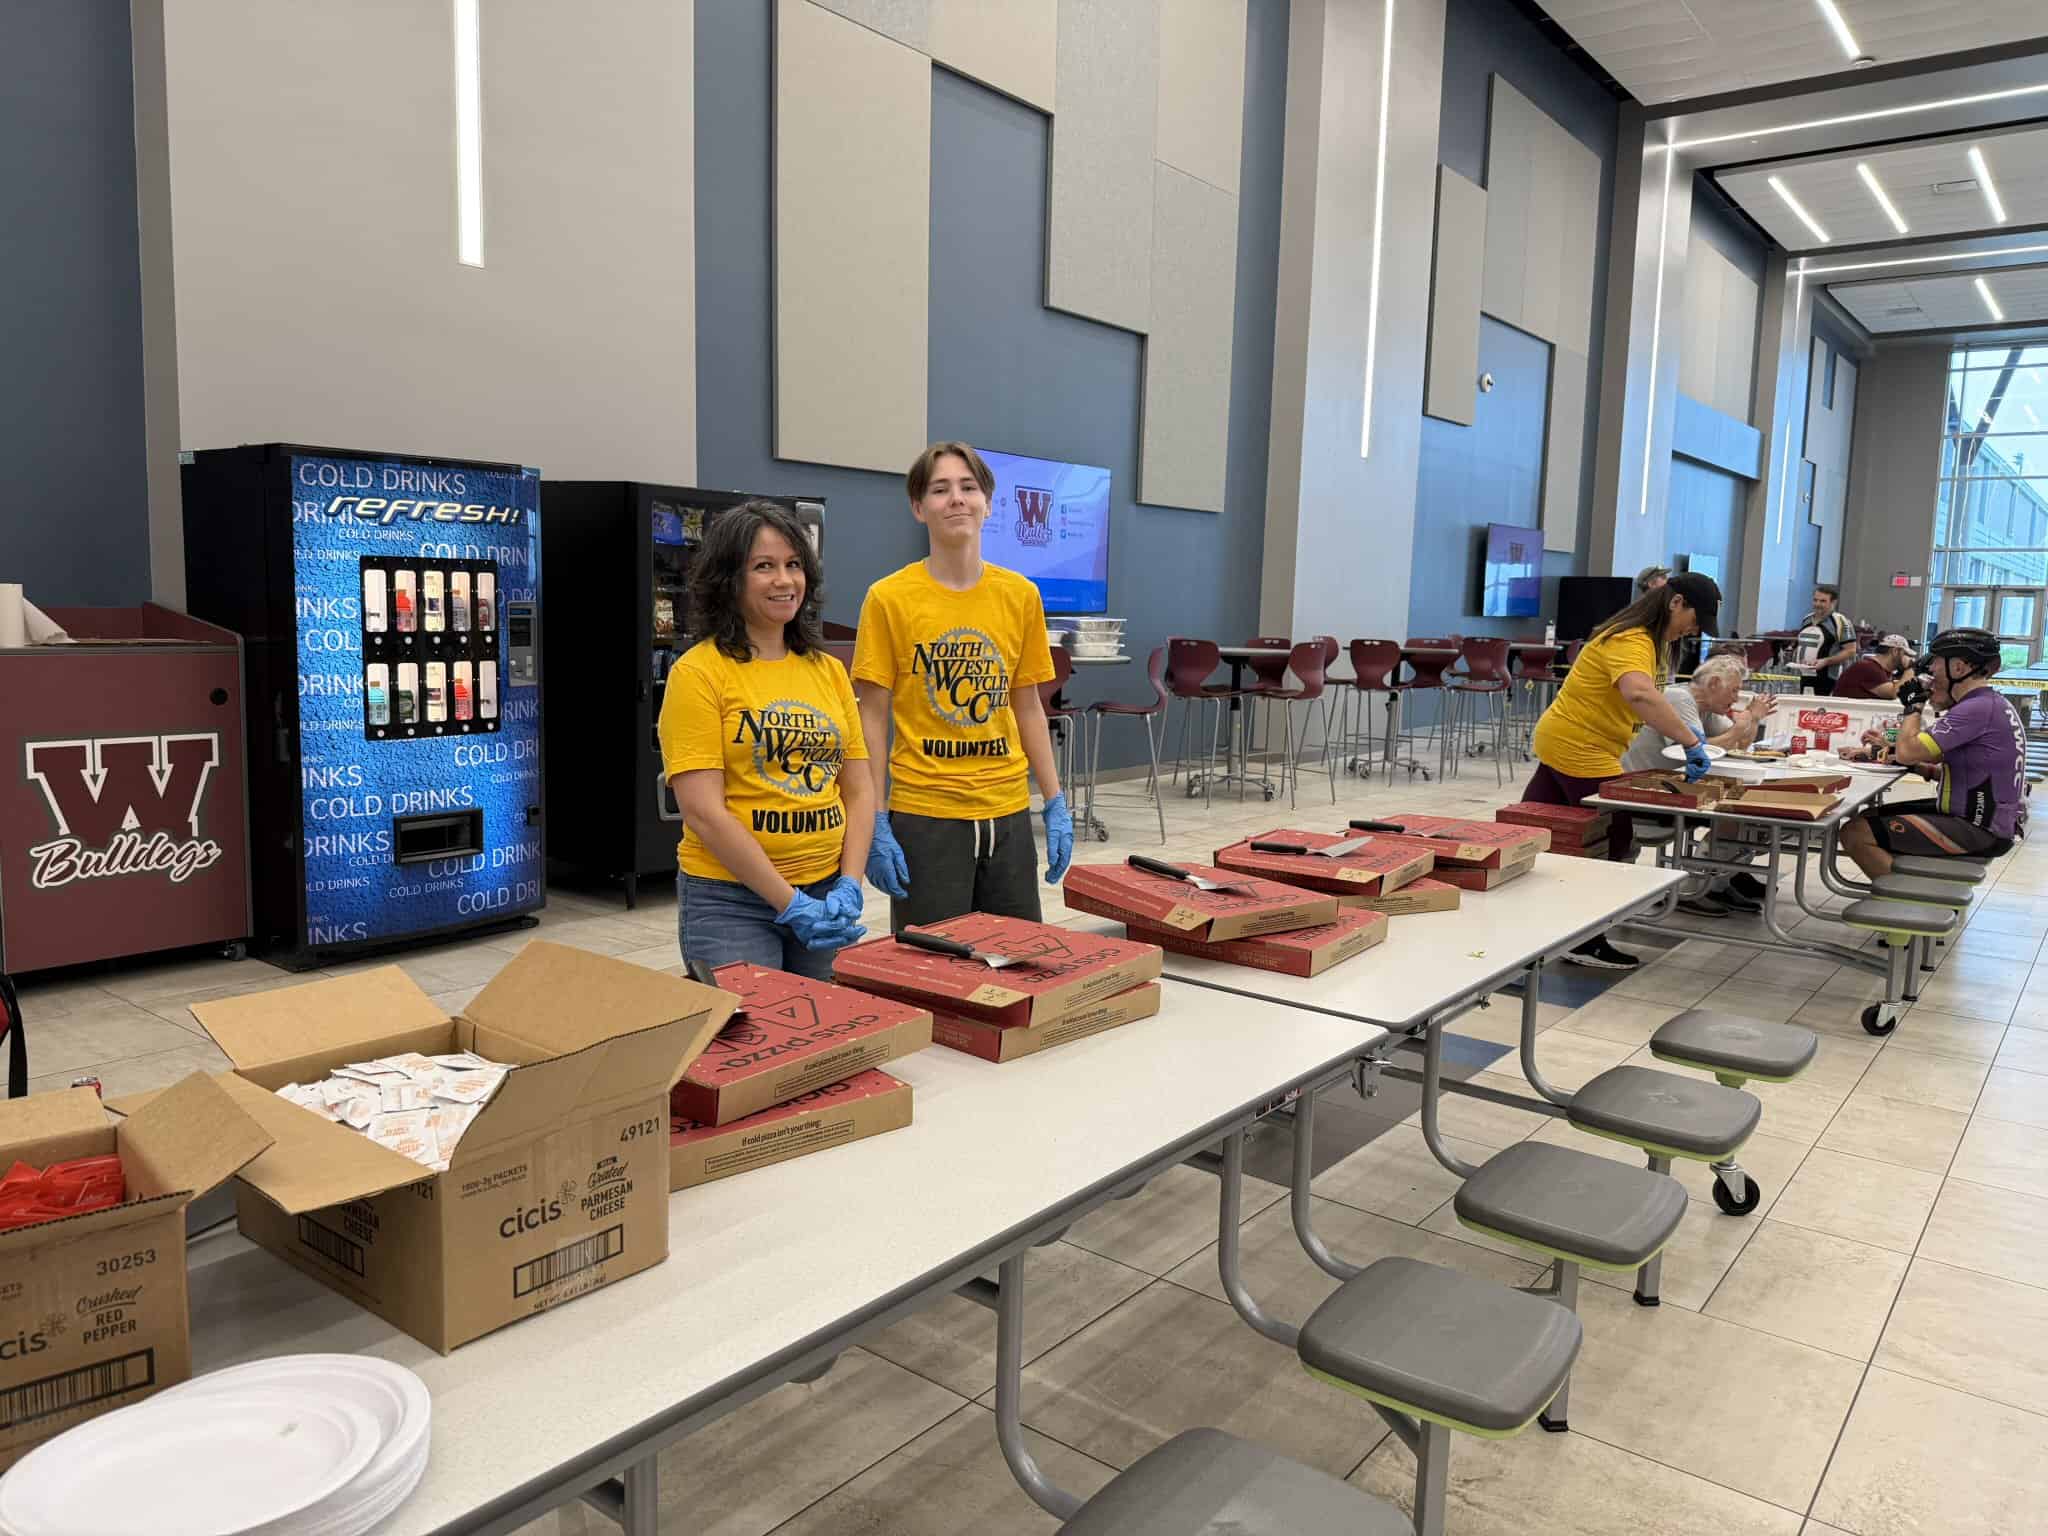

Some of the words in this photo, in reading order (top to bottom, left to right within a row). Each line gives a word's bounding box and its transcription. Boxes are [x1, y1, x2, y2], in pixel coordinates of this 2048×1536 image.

[300, 463, 373, 488] COLD
[383, 468, 466, 495] DRINKS
[1015, 486, 1053, 530] W
[912, 642, 984, 675] NORTH
[931, 659, 994, 691] WEST
[732, 709, 816, 744] NORTH
[455, 742, 508, 767] COLD
[762, 727, 831, 763] WEST
[25, 732, 220, 837] W
[311, 795, 383, 820] COLD
[392, 785, 473, 814] DRINKS
[30, 832, 222, 889] Bulldogs
[349, 855, 380, 867] COLD
[428, 852, 486, 878] COLD
[328, 876, 370, 890] DRINKS
[389, 884, 422, 898] COLD
[424, 878, 464, 893] DRINKS
[457, 886, 510, 914] COLD
[620, 1116, 661, 1143] 49121
[747, 1134, 760, 1146] cold
[580, 1179, 633, 1212] PARMESAN
[590, 1197, 625, 1221] CHEESE
[500, 1198, 562, 1238] cicis
[96, 1247, 157, 1276] 30253
[76, 1285, 143, 1315] Crushed
[96, 1308, 123, 1327] RED
[83, 1320, 137, 1345] PEPPER
